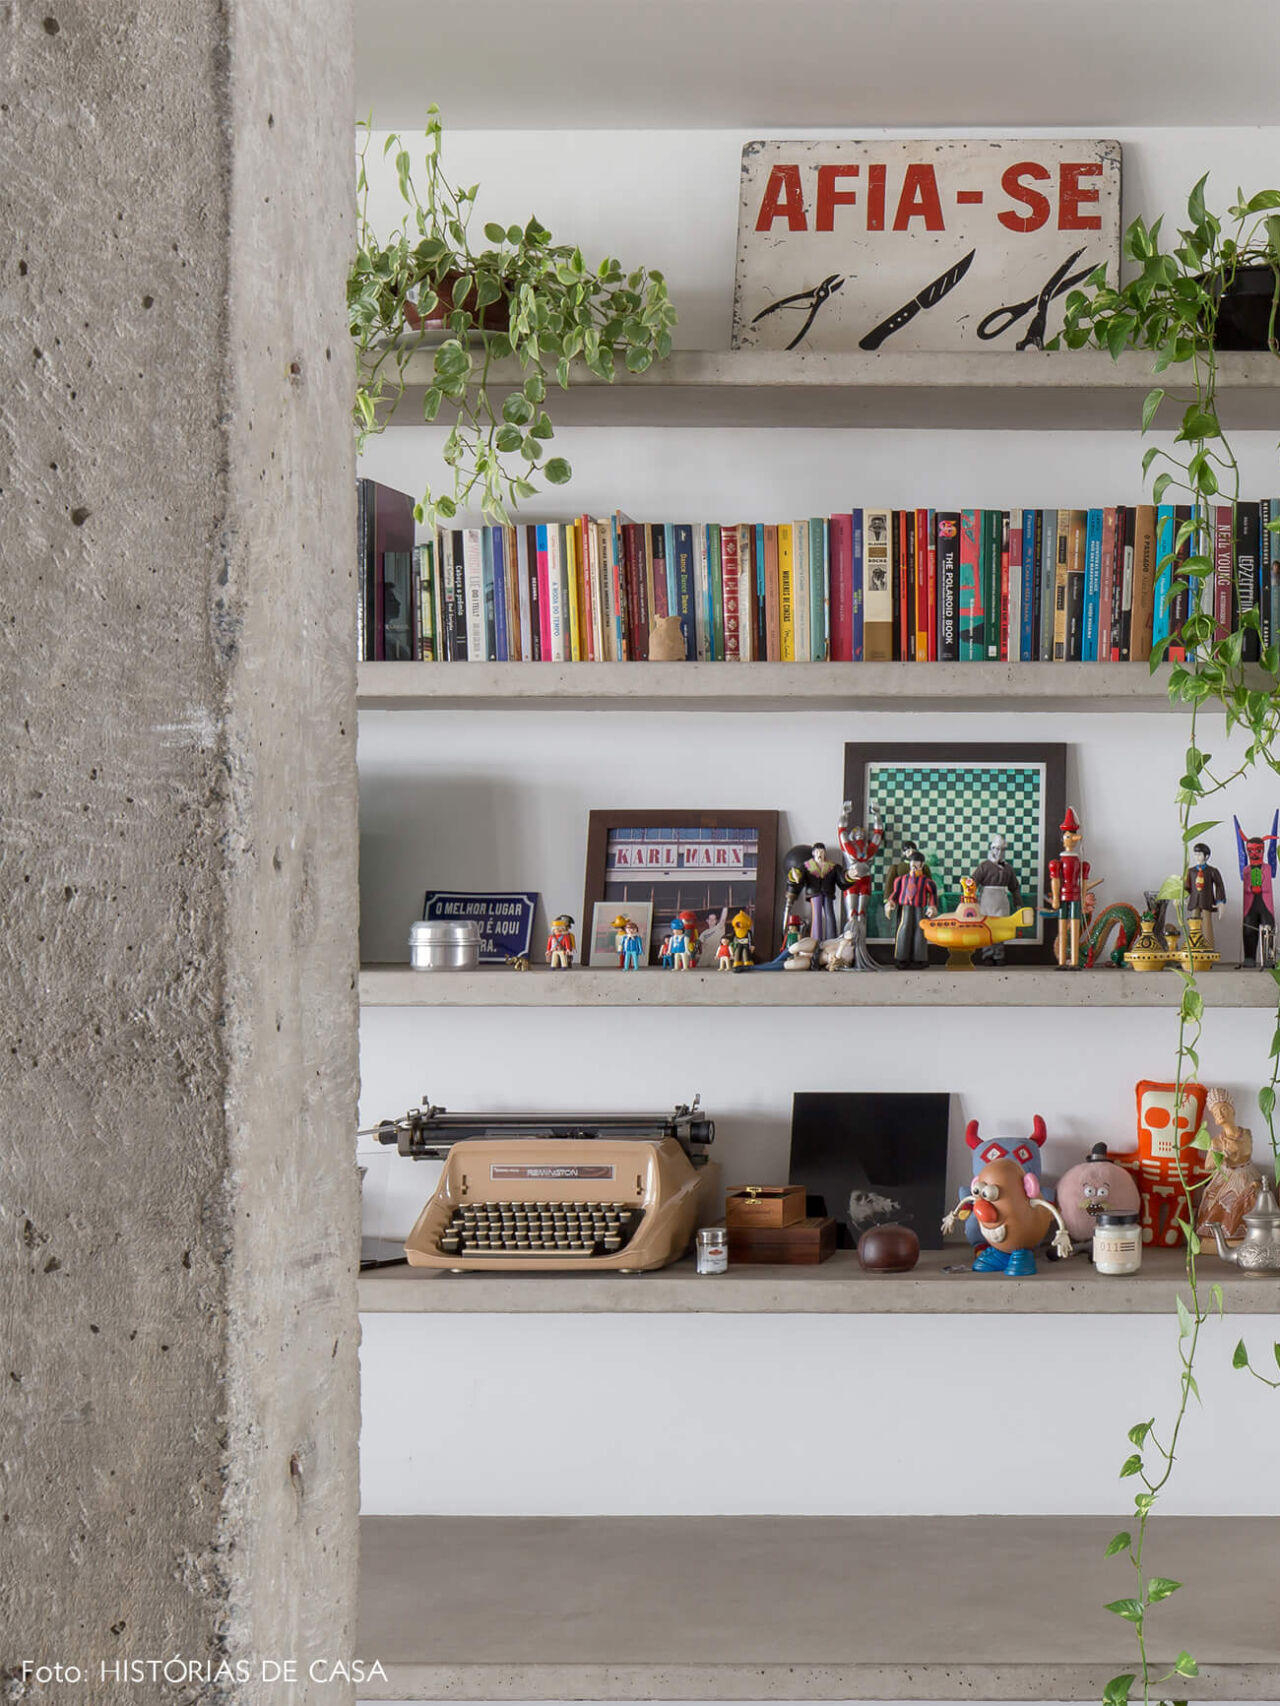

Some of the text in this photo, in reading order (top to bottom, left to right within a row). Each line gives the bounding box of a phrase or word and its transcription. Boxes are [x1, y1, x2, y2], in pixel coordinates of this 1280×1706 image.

[755, 162, 1103, 232] AFIA-SE
[1218, 525, 1230, 548] NEIL
[455, 565, 463, 588] Cabeça
[1218, 552, 1230, 586] YOUNG
[469, 576, 480, 587] LIE
[553, 606, 559, 614] DO
[783, 605, 791, 622] CINZAS
[945, 619, 953, 644] BOOK
[617, 848, 742, 864] KARL MARX
[436, 902, 522, 915] O MELHOR LUGAR
[486, 918, 493, 934] É
[495, 921, 520, 936] AQUI
[1100, 1242, 1119, 1252] 011
